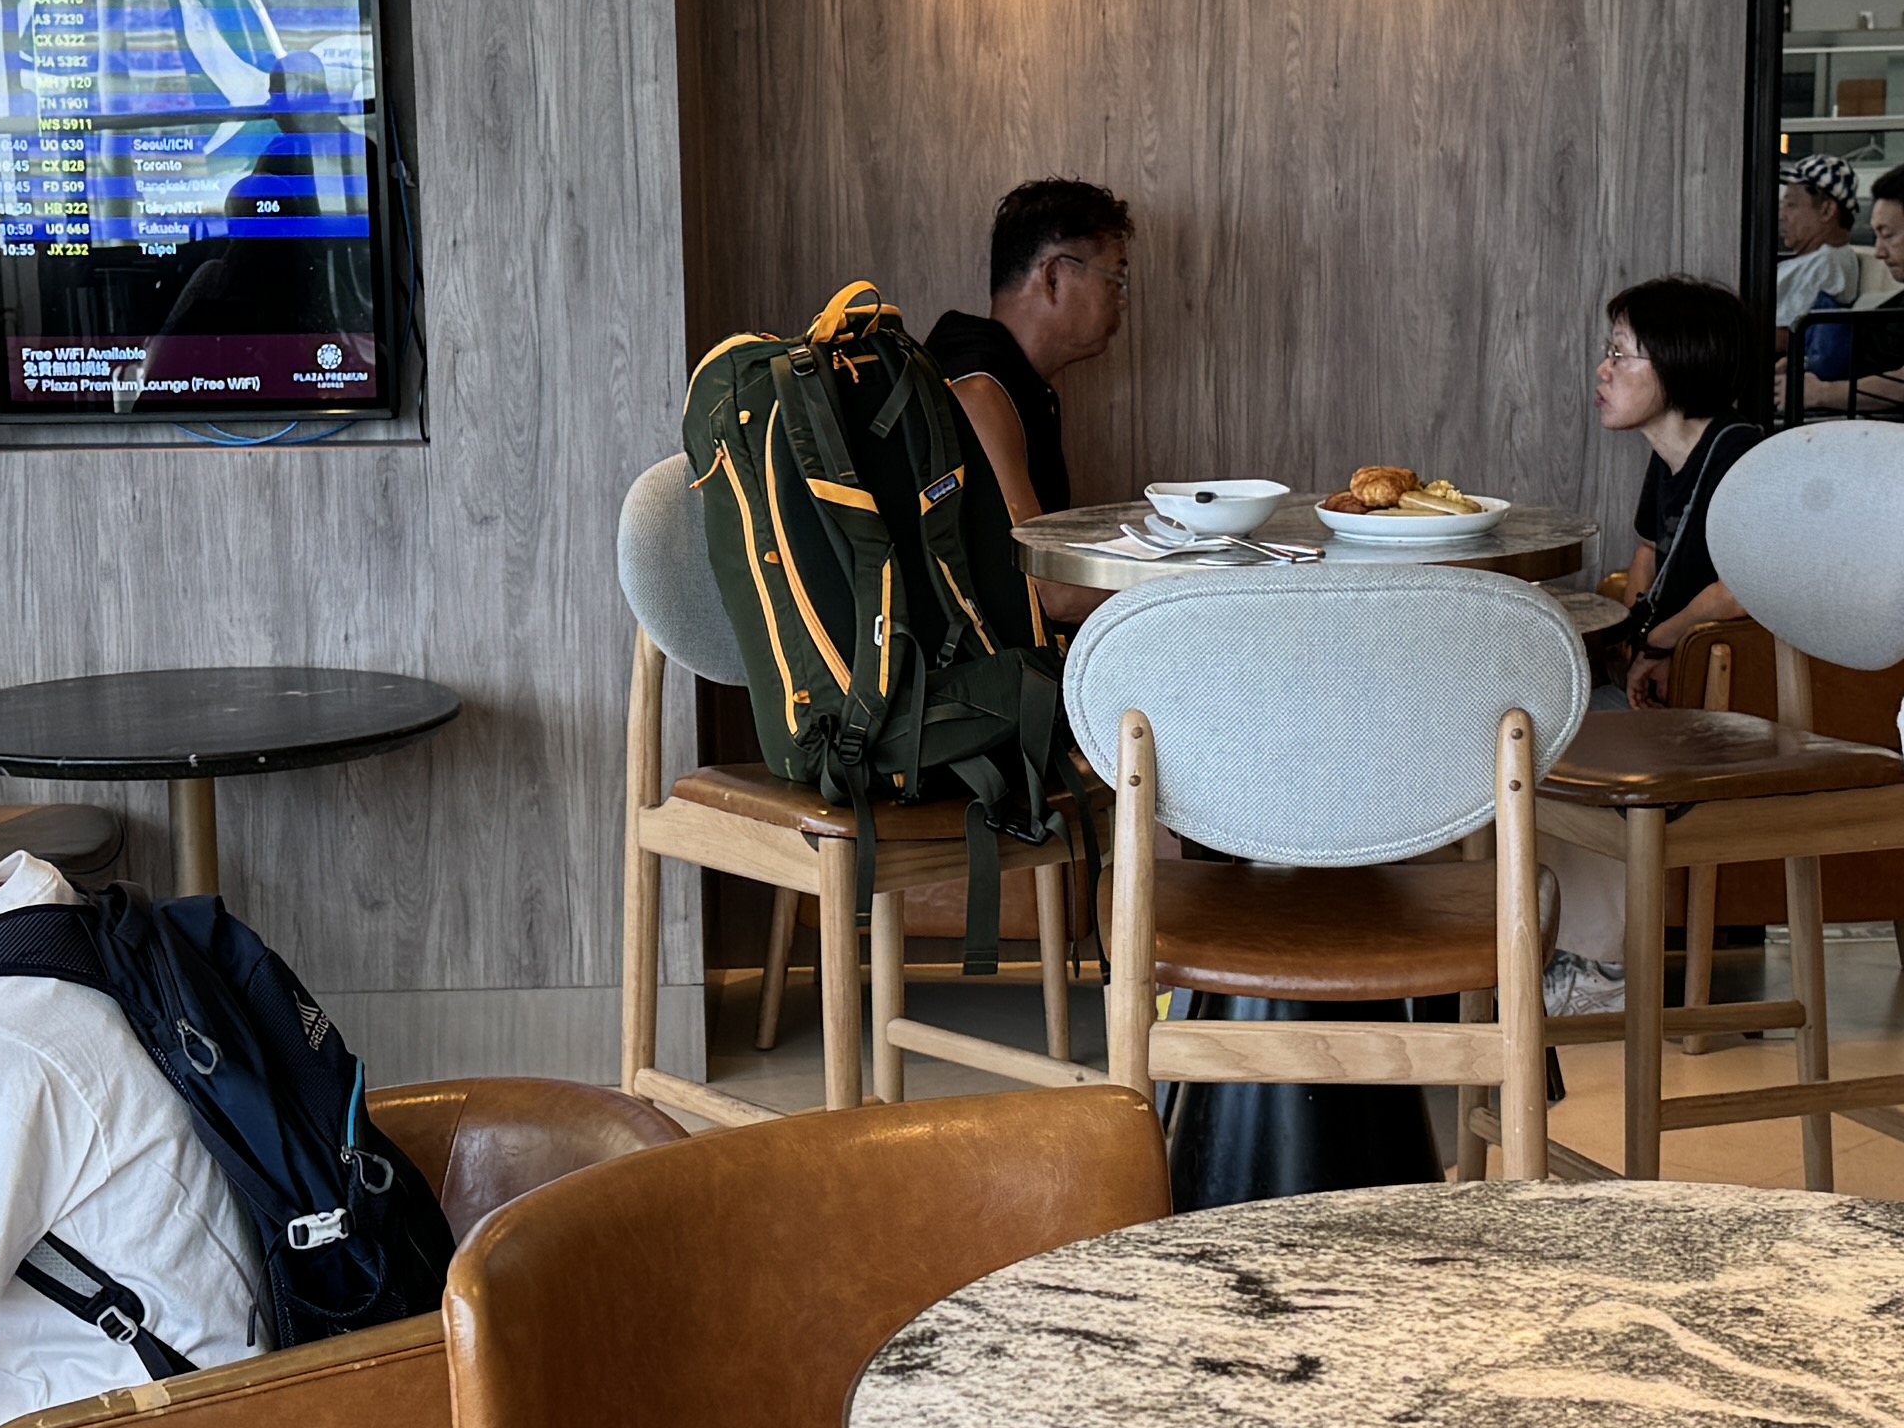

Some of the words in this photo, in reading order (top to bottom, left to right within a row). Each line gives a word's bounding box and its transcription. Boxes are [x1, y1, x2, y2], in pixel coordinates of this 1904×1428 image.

[39, 118, 61, 131] WS
[62, 118, 93, 131] 5911
[60, 139, 85, 152] 630
[132, 138, 194, 152] Seoul/ICN
[41, 160, 60, 172] CX
[133, 159, 183, 172] Toronto
[42, 181, 59, 193] FD
[61, 181, 85, 193] 509
[64, 202, 89, 215] 322
[255, 200, 281, 213] 206
[1, 223, 34, 236] 10:50
[138, 222, 190, 235] Fukuoka
[1, 244, 36, 256] 10:55
[46, 243, 64, 256] JX
[65, 243, 90, 256] 232
[138, 242, 177, 258] Taipei
[21, 347, 53, 361] Free
[86, 346, 147, 361] Available
[293, 372, 324, 382] PLAZA
[324, 372, 368, 382] PREMIUM
[41, 378, 78, 392] Plaza
[80, 378, 138, 392] Premium
[139, 378, 190, 394] Lounge
[191, 376, 226, 393] (Free
